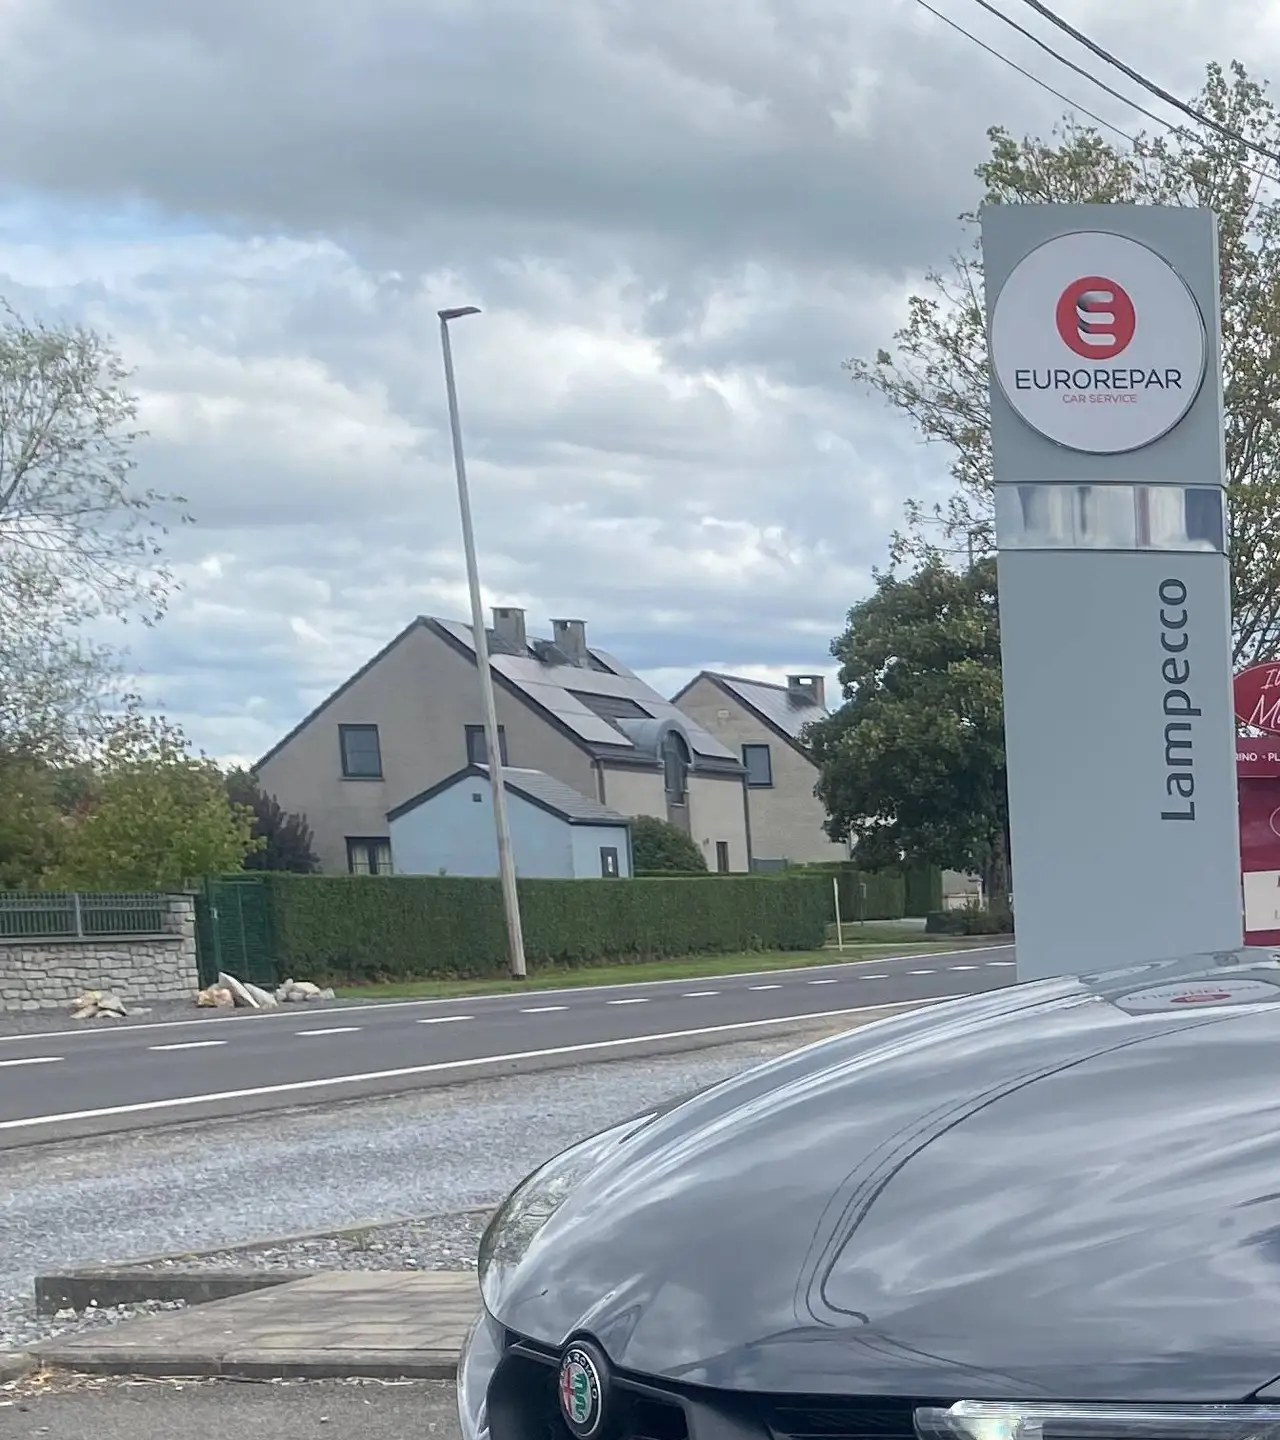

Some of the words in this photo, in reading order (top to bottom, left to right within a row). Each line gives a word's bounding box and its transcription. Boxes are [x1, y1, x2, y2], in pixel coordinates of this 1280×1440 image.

[1015, 369, 1182, 390] EUROREPAR
[1062, 394, 1086, 404] CAR
[1089, 394, 1138, 404] SERVICE
[1158, 578, 1202, 821] Lampecco
